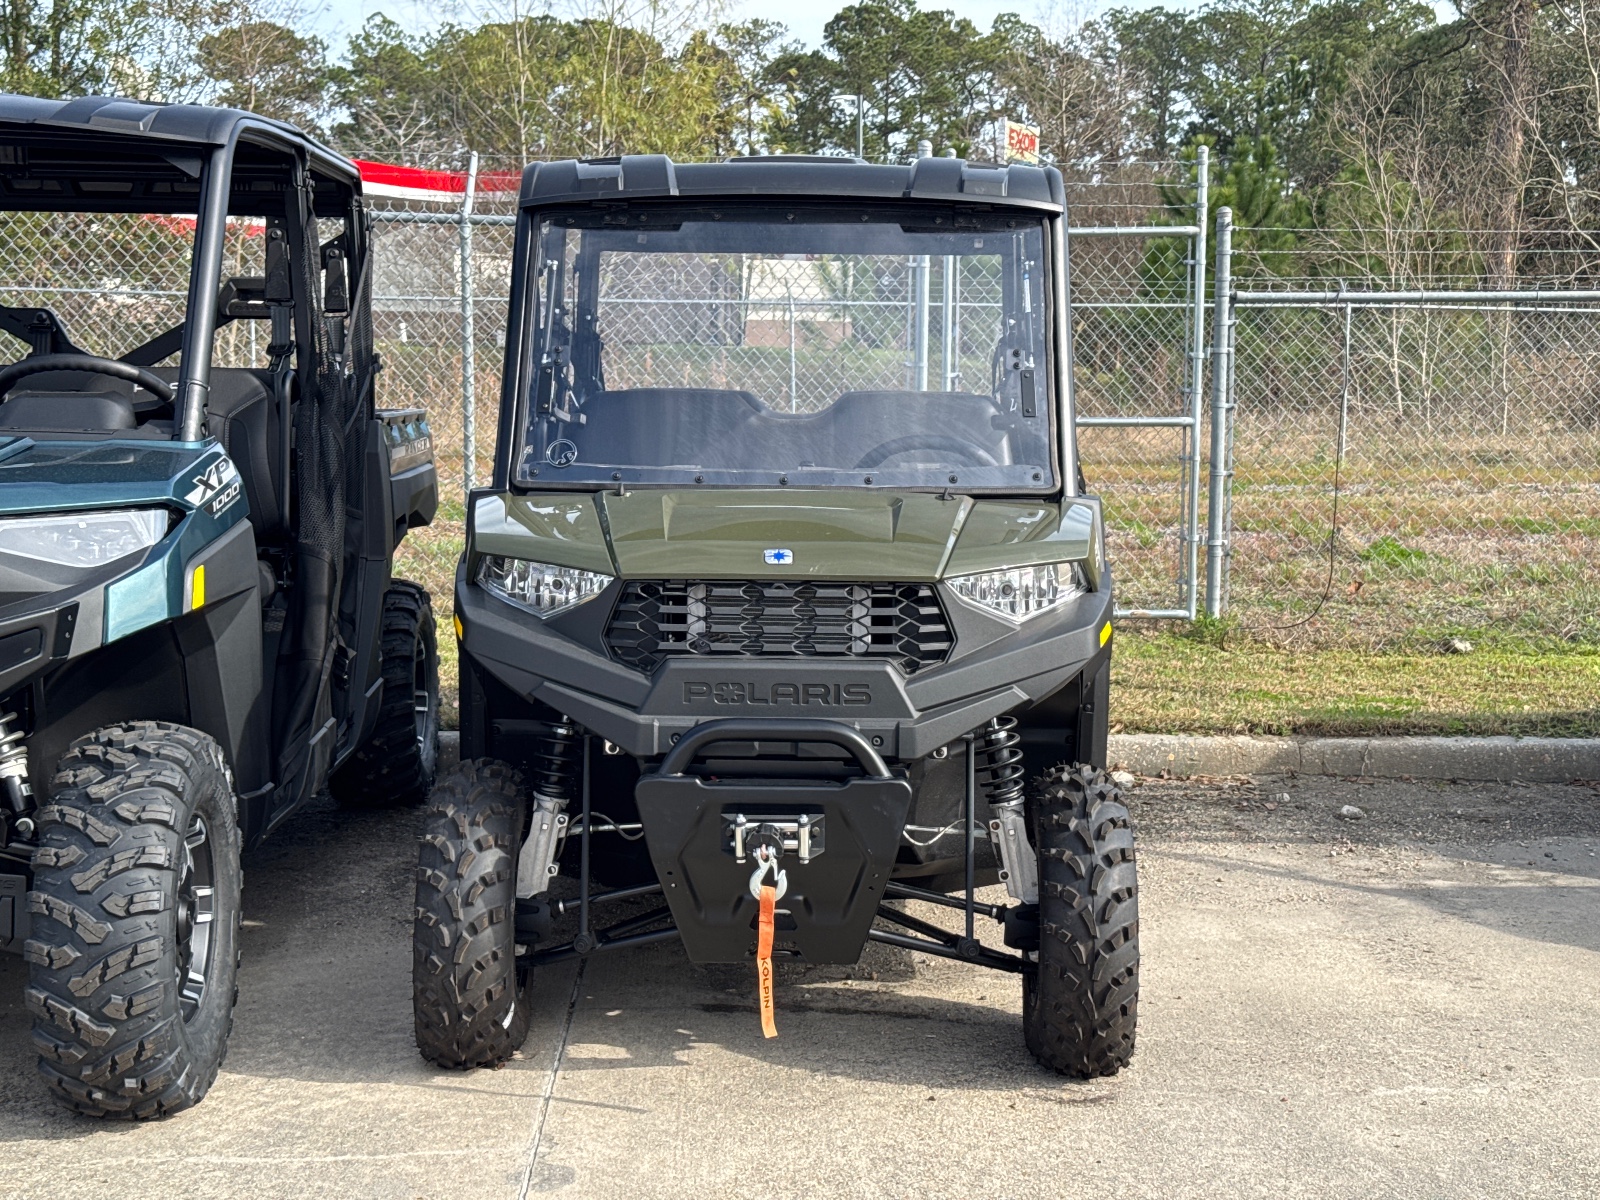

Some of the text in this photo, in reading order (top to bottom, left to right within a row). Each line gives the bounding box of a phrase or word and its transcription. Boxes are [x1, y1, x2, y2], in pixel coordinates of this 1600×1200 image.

[195, 455, 231, 504] XP
[212, 481, 240, 513] 1000
[683, 681, 872, 706] POLARIS
[760, 957, 771, 1009] KOLPIN
